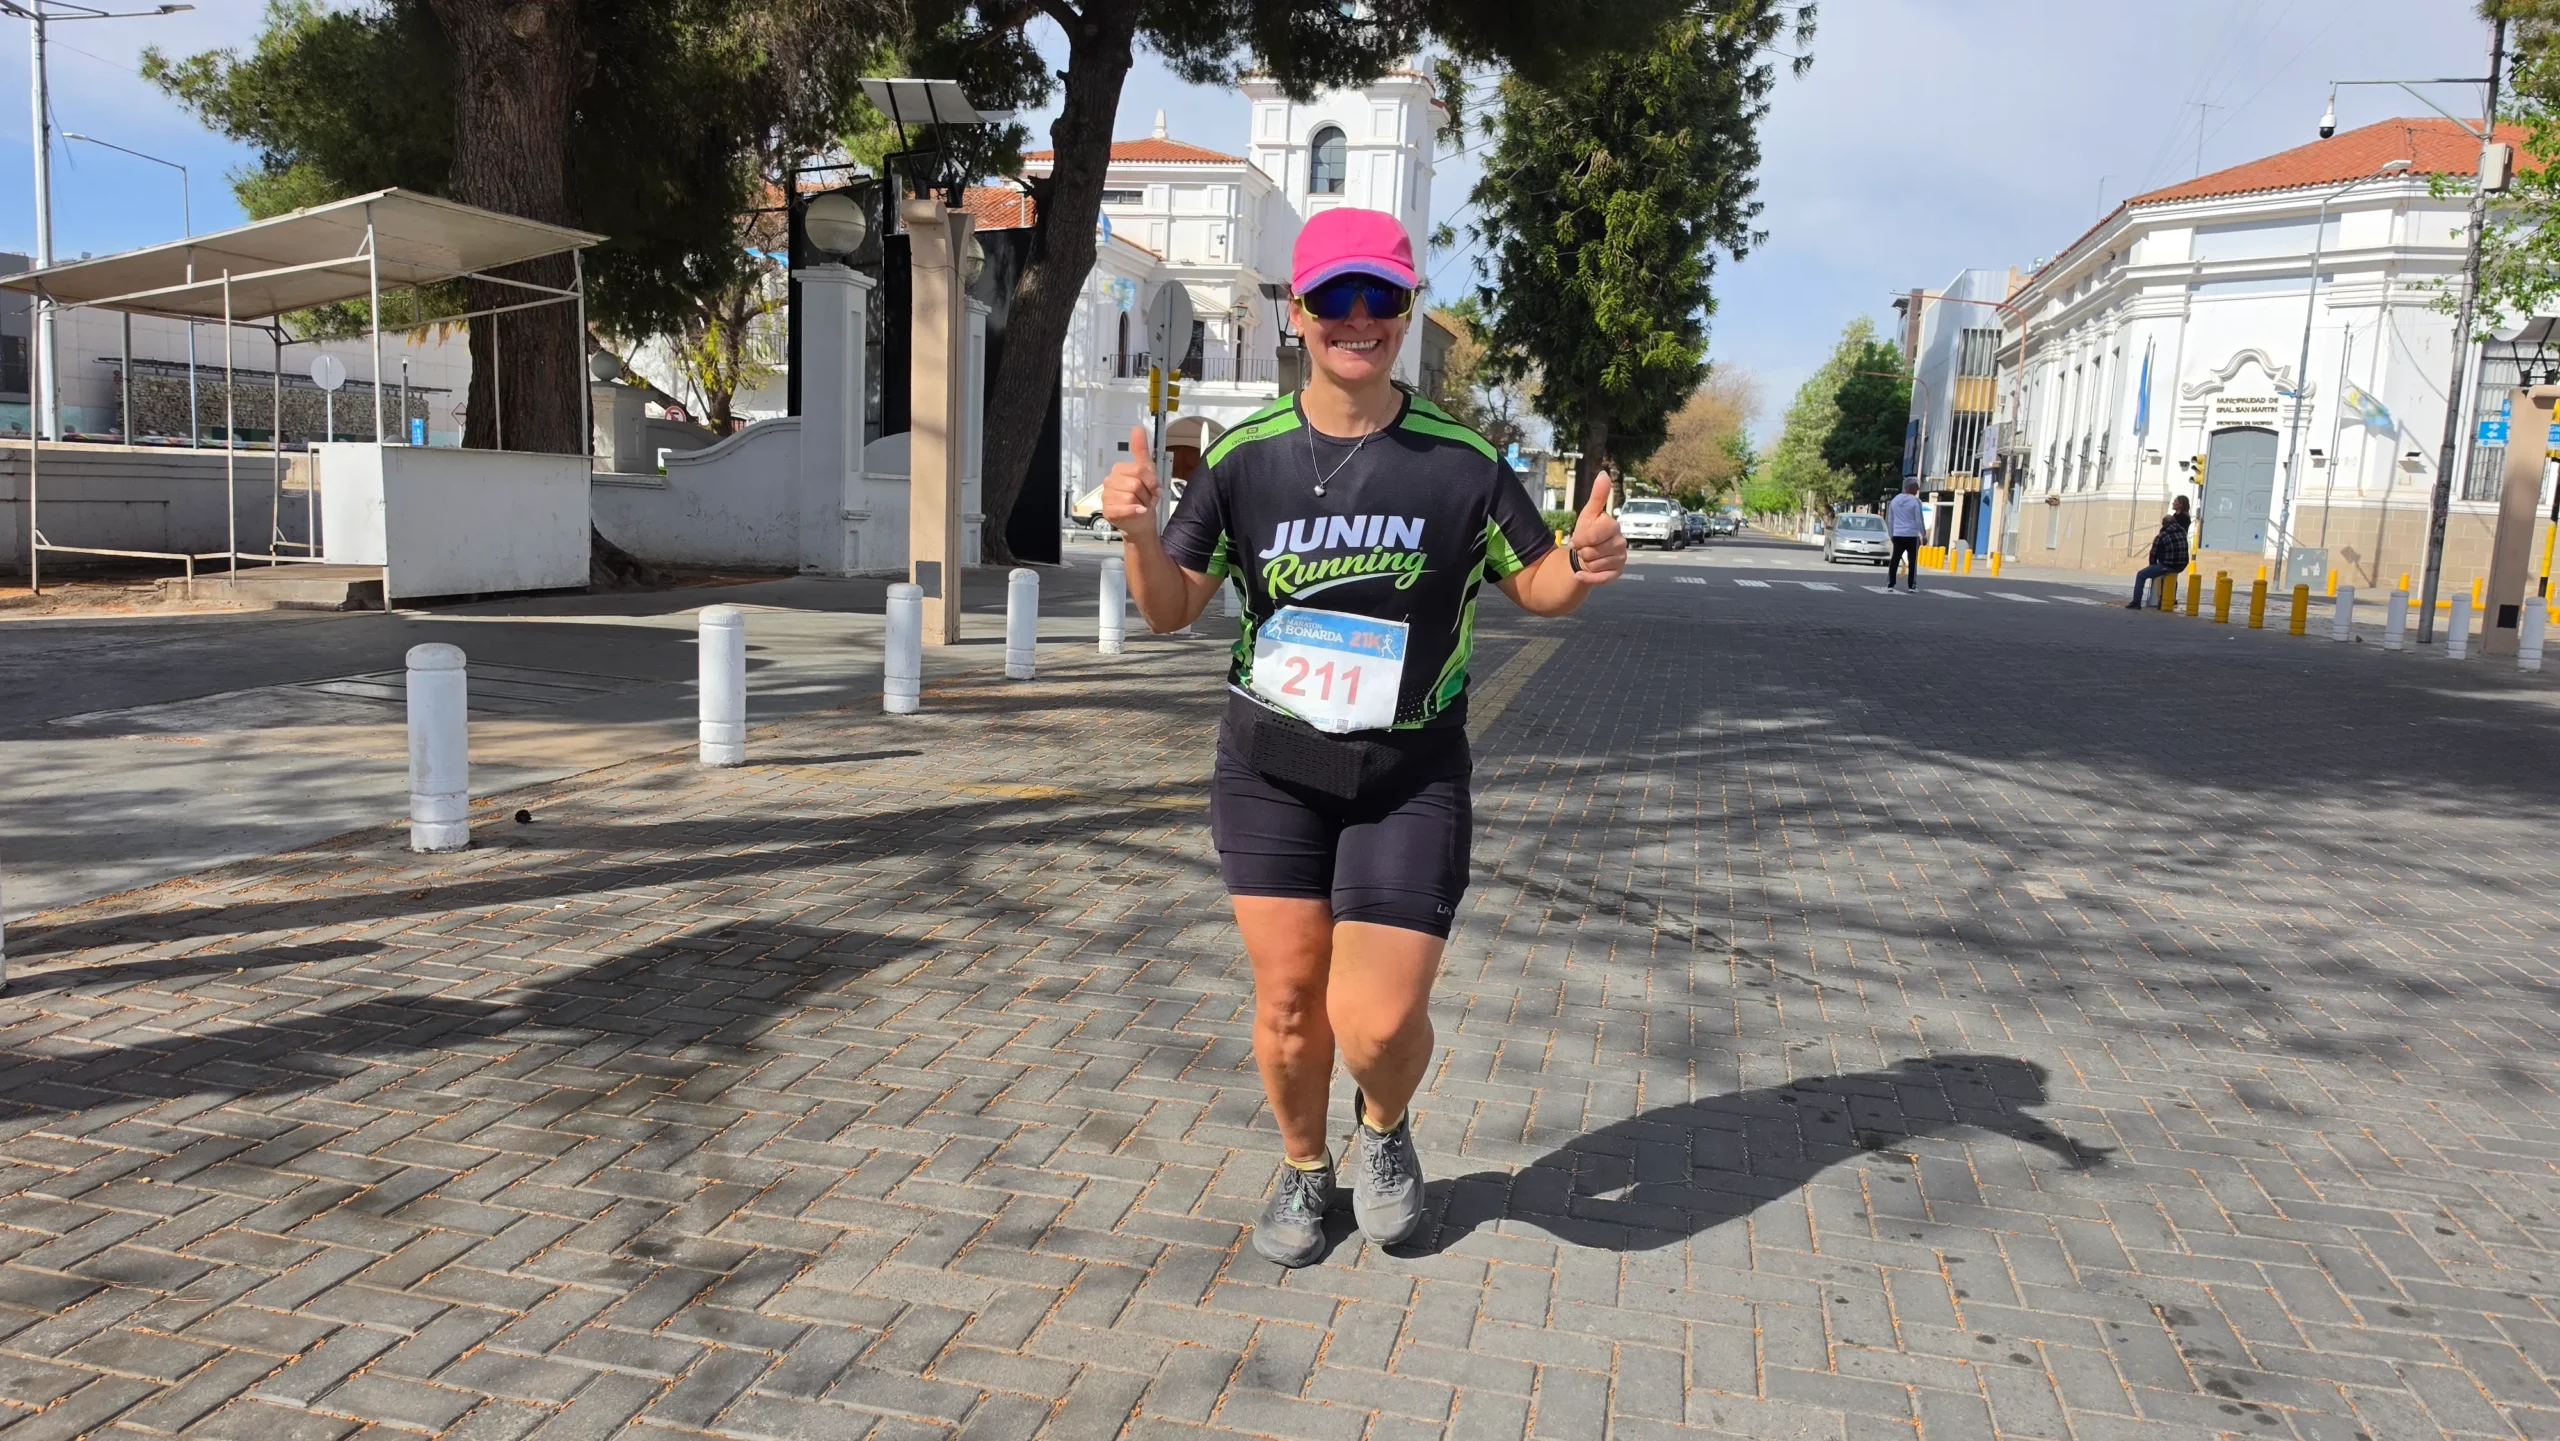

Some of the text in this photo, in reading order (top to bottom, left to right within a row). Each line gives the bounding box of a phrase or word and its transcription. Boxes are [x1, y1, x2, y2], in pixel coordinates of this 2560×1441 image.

[1258, 514, 1426, 559] JUNIN
[1262, 545, 1429, 600] Running
[1285, 625, 1383, 651] BONARDA 21K
[1280, 656, 1362, 706] 211
